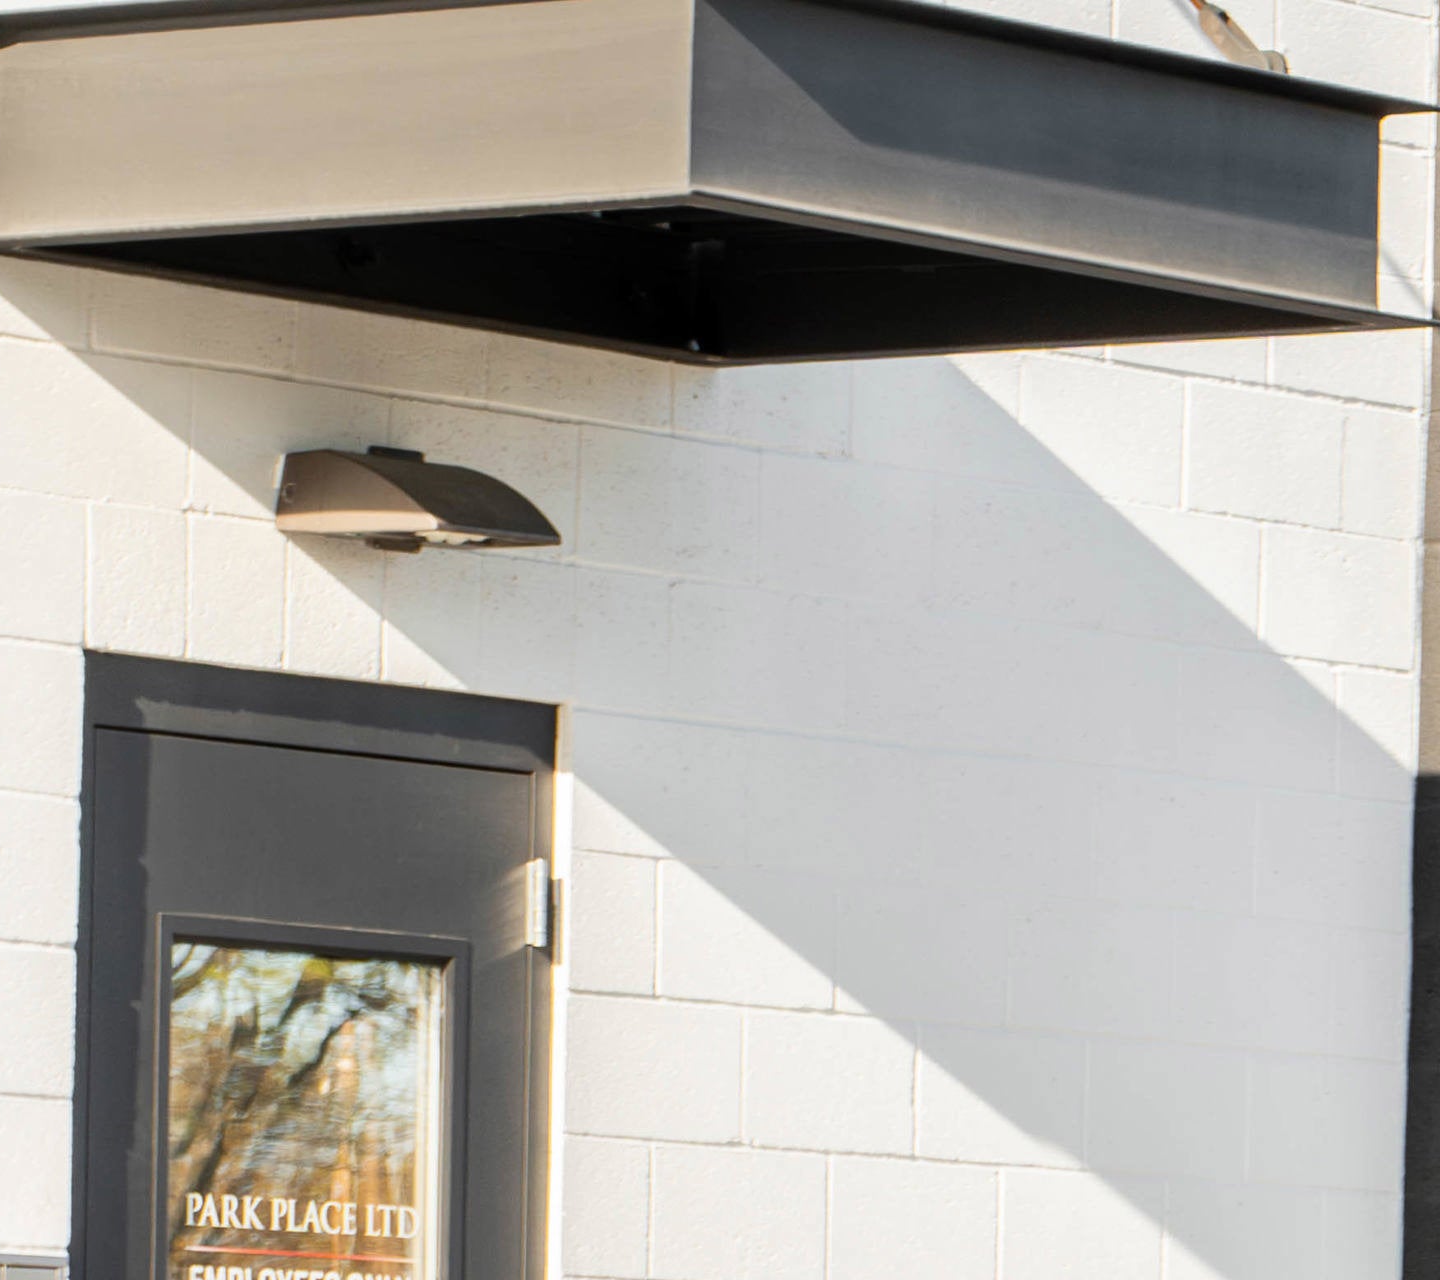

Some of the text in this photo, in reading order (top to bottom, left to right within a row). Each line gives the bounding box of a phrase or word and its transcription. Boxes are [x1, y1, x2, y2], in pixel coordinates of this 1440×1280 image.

[186, 1193, 421, 1240] PARK PLACE LTD
